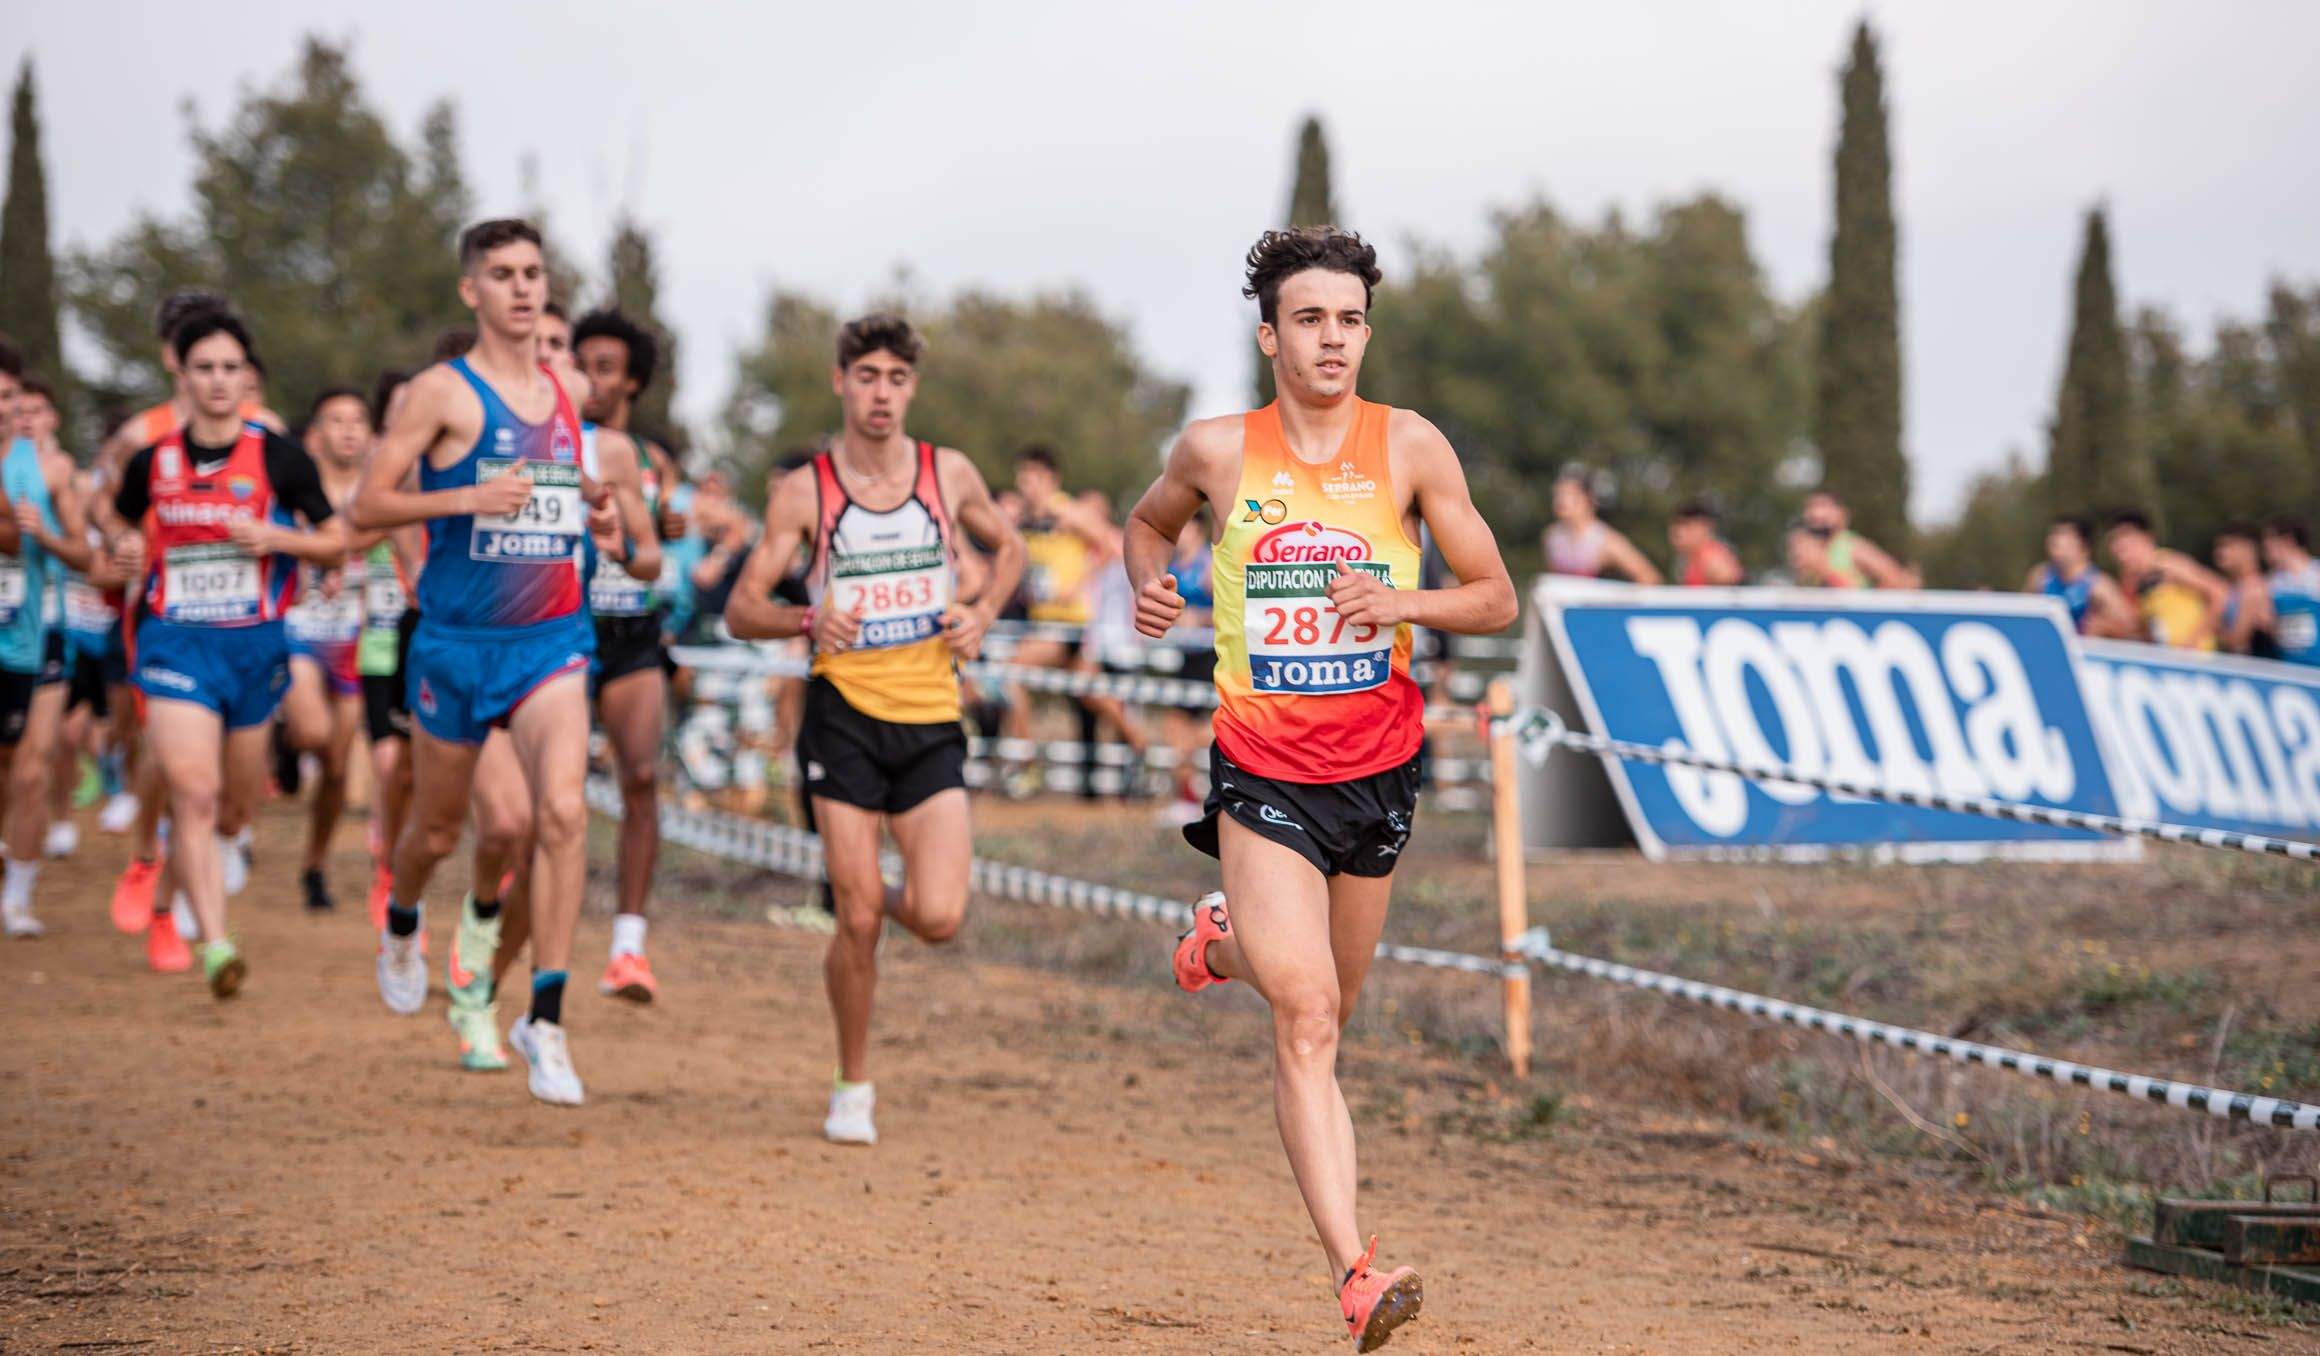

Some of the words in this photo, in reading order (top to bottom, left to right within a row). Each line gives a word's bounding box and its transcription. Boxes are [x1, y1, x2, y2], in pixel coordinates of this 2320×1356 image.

[503, 497, 561, 523] 49
[1264, 538, 1362, 573] Serrano
[852, 576, 931, 615] 2863
[1248, 570, 1324, 589] DIPUTACION
[1626, 616, 2076, 836] Joma
